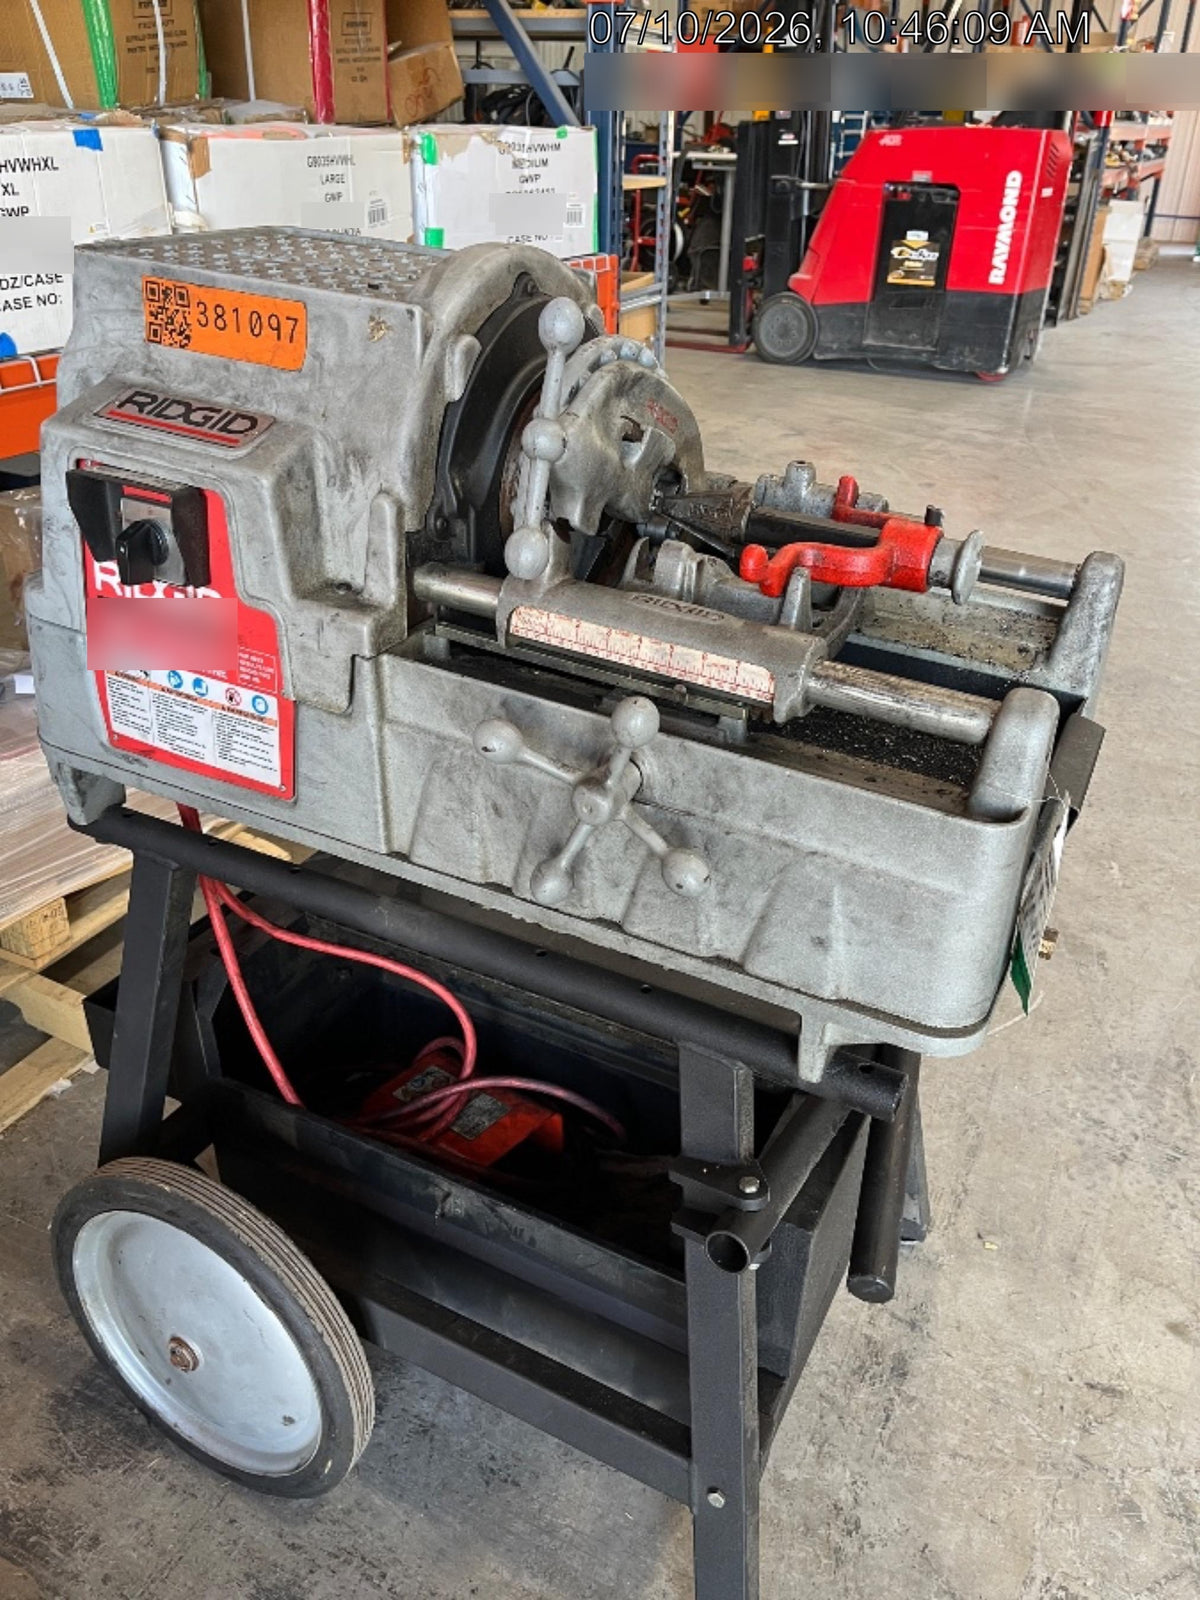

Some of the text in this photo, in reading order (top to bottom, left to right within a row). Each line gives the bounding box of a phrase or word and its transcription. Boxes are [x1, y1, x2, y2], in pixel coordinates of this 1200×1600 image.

[1, 182, 20, 196] XL
[320, 173, 345, 185] LARGE
[988, 170, 1023, 285] RAYMOND
[0, 292, 63, 312] ASE NO:
[196, 301, 299, 343] 381097
[116, 390, 259, 435] RIDGID
